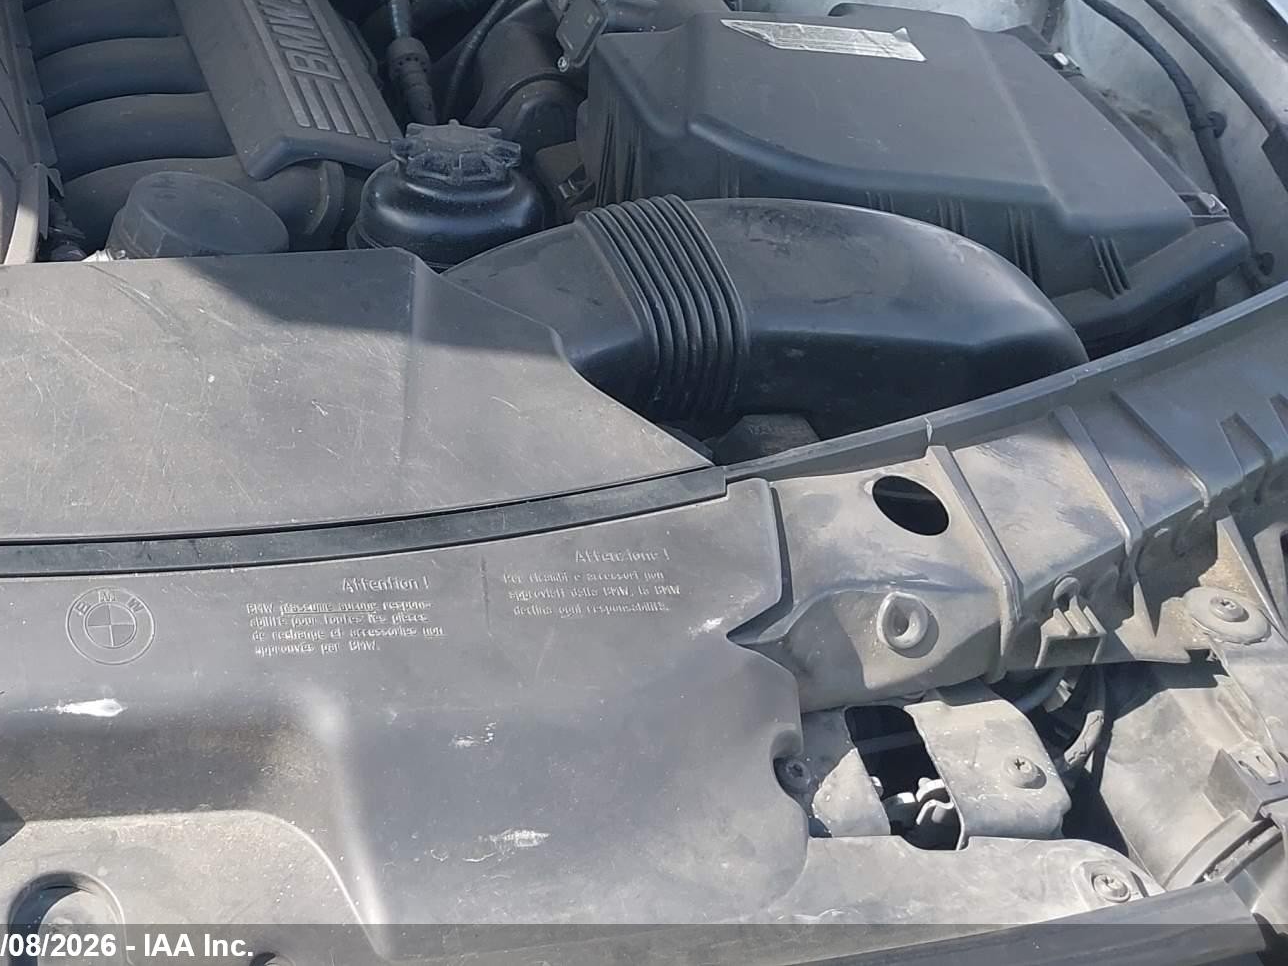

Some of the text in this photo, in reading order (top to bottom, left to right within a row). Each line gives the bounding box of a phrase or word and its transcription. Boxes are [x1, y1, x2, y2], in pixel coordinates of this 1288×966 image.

[254, 0, 342, 81] BMW
[342, 576, 419, 593] Attention
[654, 584, 681, 595] BMW
[246, 602, 274, 614] BMW
